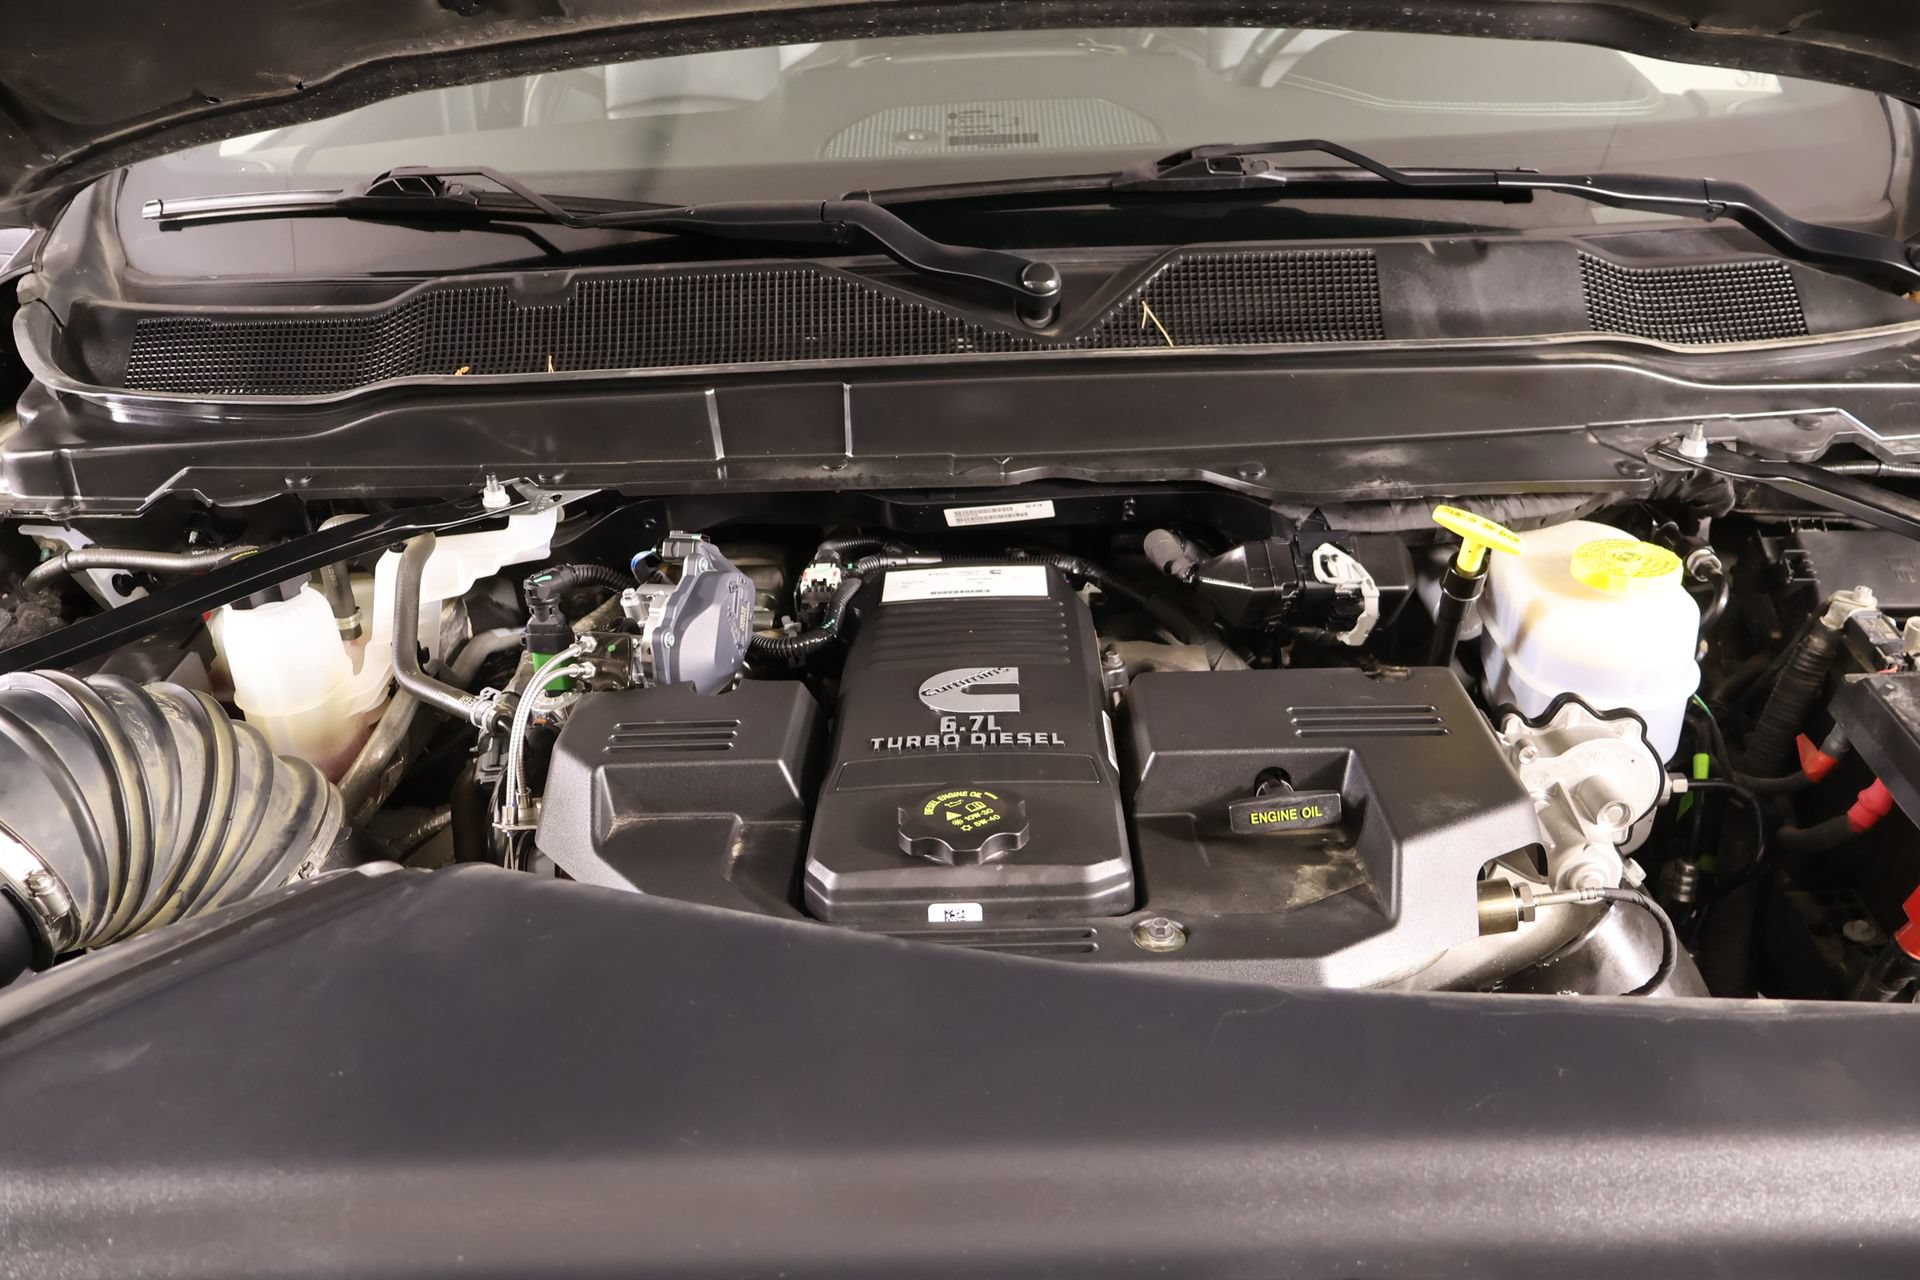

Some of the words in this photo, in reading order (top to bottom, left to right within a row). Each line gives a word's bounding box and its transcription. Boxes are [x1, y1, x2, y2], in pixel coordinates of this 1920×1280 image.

[940, 715, 1001, 733] 6.7L
[871, 734, 961, 750] TURBO
[970, 732, 1065, 748] DIESEL
[936, 790, 969, 802] ENGINE
[1250, 808, 1298, 825] ENGINE
[1301, 806, 1323, 819] OIL
